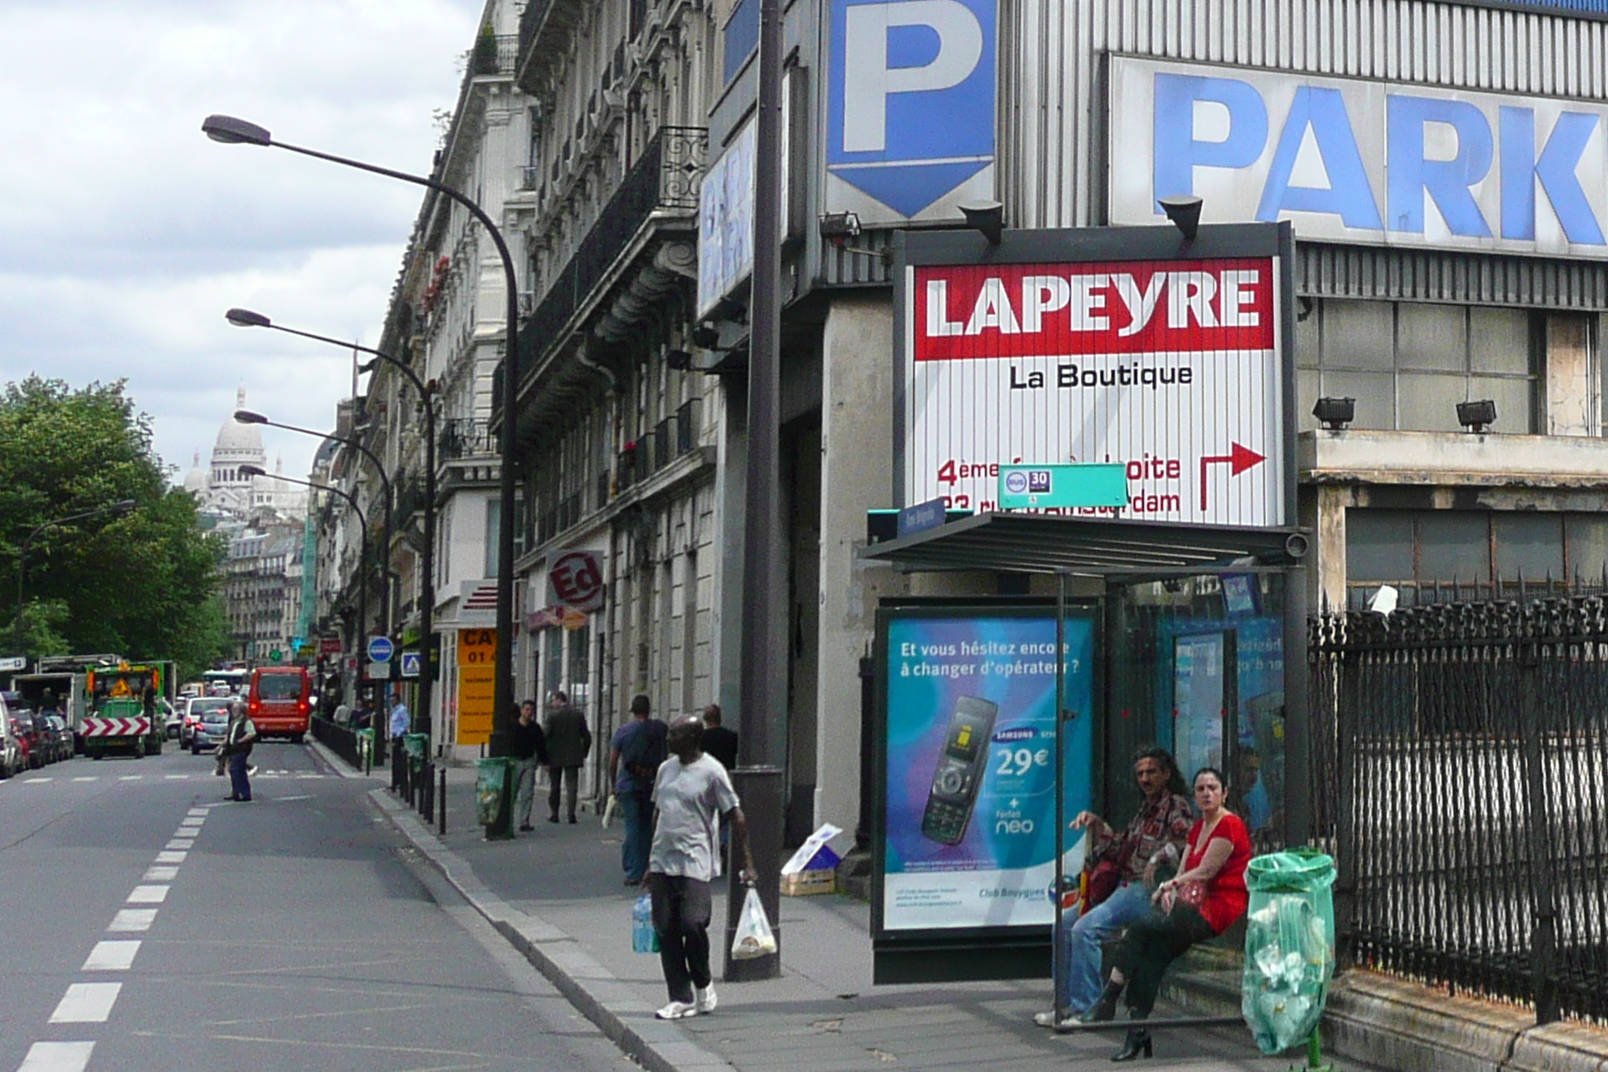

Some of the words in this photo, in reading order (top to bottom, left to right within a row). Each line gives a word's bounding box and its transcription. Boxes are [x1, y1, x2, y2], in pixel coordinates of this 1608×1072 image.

[926, 270, 1260, 337] LAPEYRE
[1010, 365, 1044, 390] La
[1057, 361, 1193, 390] Boutique
[1104, 452, 1182, 480] oite
[1031, 472, 1047, 484] 30
[550, 555, 602, 600] Ed
[901, 642, 916, 657] Et
[921, 643, 956, 656] vous
[961, 641, 1016, 656] hésitez
[1020, 642, 1070, 656] encoe
[913, 662, 976, 679] changer
[996, 819, 1034, 834] neo
[979, 888, 999, 898] Club
